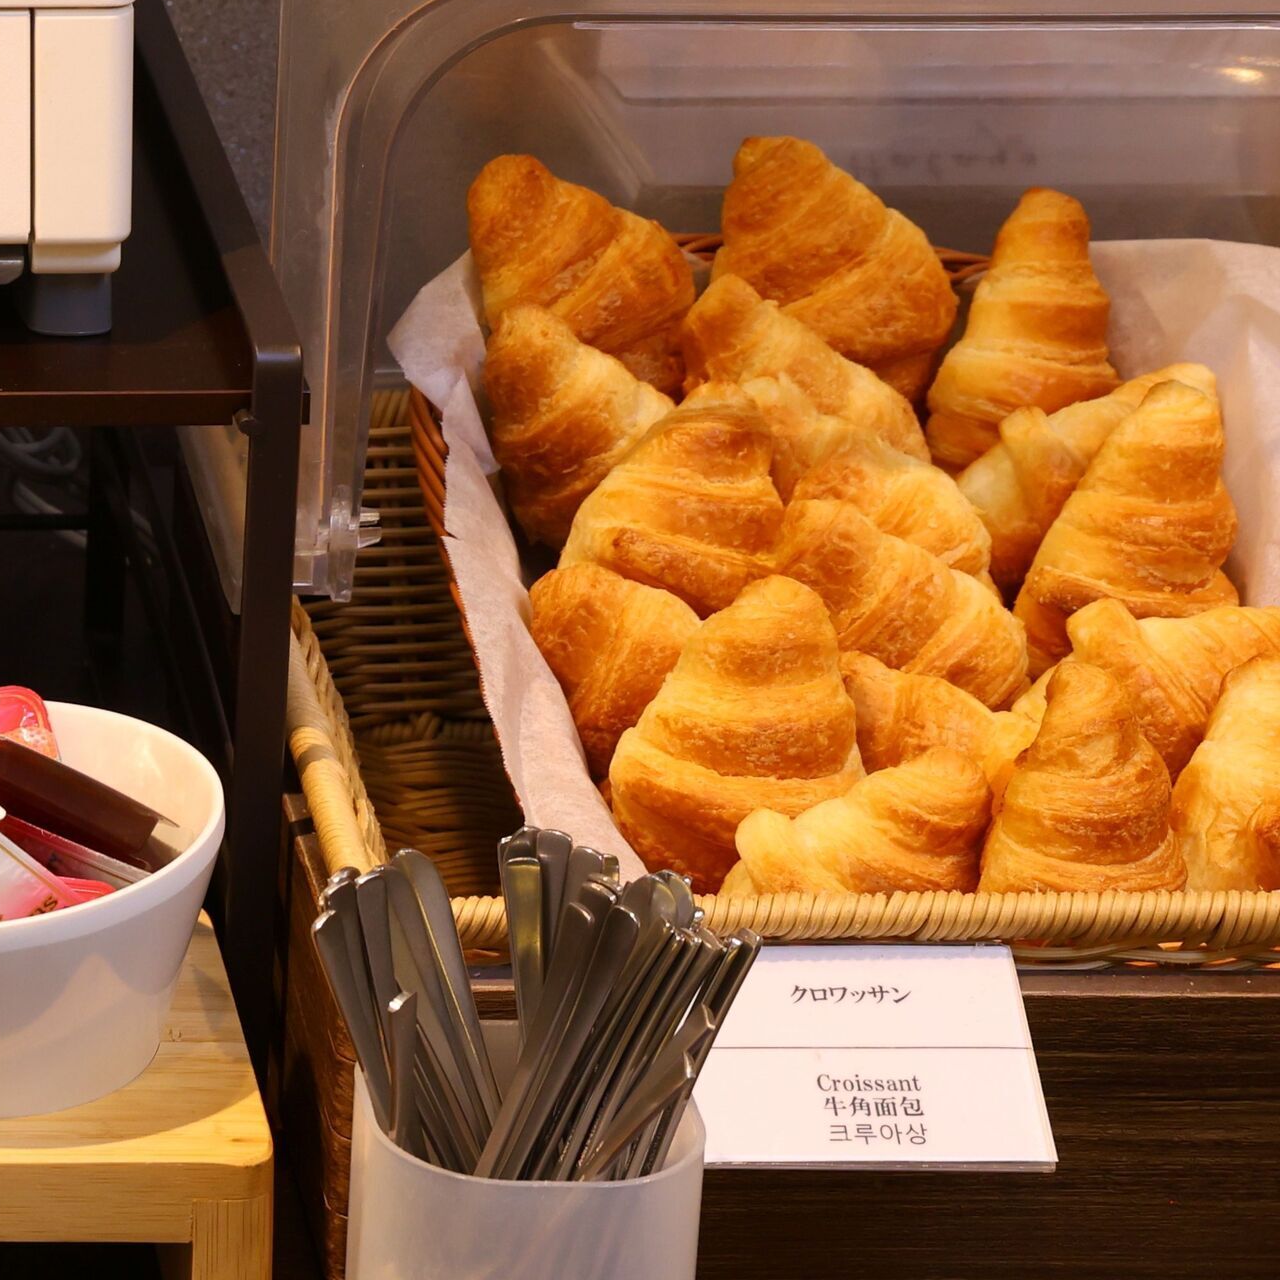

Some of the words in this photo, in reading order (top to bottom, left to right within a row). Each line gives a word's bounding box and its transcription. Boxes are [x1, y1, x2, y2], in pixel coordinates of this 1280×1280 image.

[790, 984, 912, 1005] クロワッサン
[817, 1073, 922, 1093] Croissant
[823, 1096, 925, 1117] 牛角面包
[829, 1123, 928, 1145] 크루아상
